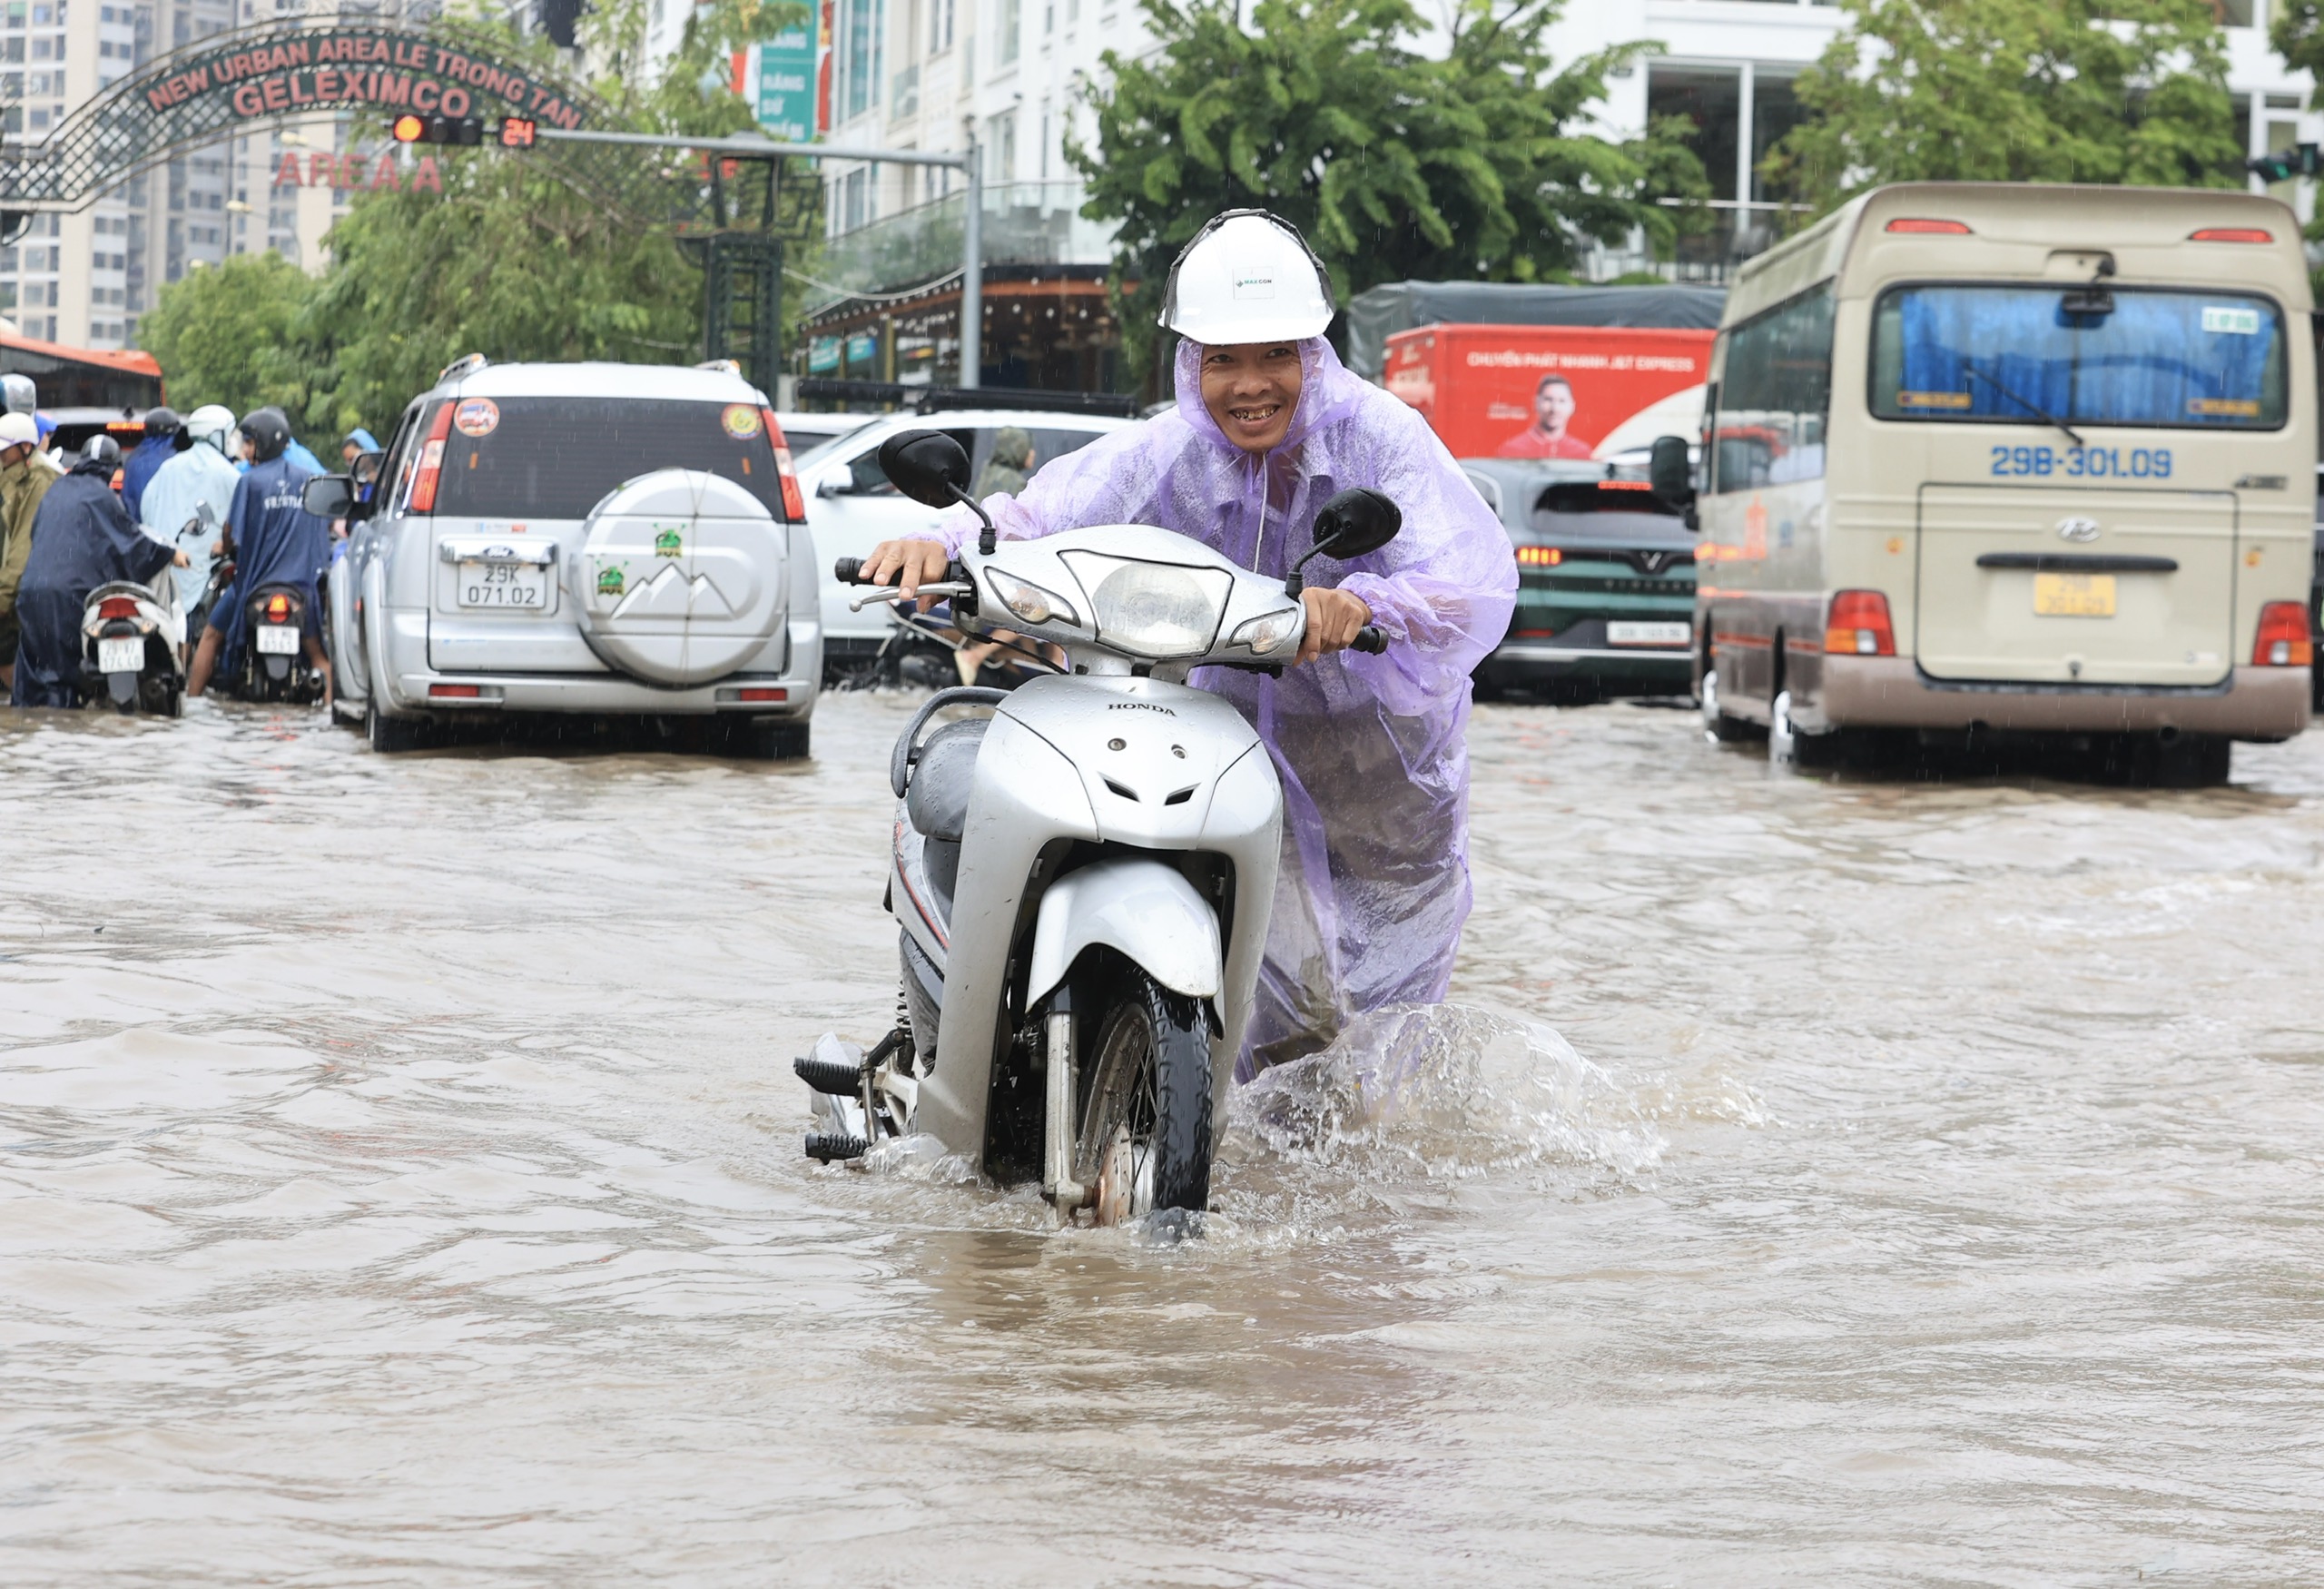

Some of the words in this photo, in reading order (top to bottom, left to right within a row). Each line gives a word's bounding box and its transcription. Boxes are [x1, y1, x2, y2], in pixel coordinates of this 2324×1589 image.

[147, 66, 210, 112] NEW
[212, 36, 311, 83] URBAN
[316, 36, 391, 64] AREA
[395, 41, 427, 70] LE
[435, 49, 528, 104] TRONG
[527, 90, 582, 131] TAN
[232, 71, 471, 119] GELEXIMCO
[502, 119, 536, 146] 24
[274, 153, 402, 192] AREA
[413, 156, 443, 193] A
[1635, 356, 1696, 372] EXPRESS
[1991, 446, 2171, 478] 29B-301.09
[485, 565, 519, 584] 29K
[468, 587, 536, 605] 071.02
[1108, 703, 1177, 717] HONDA
